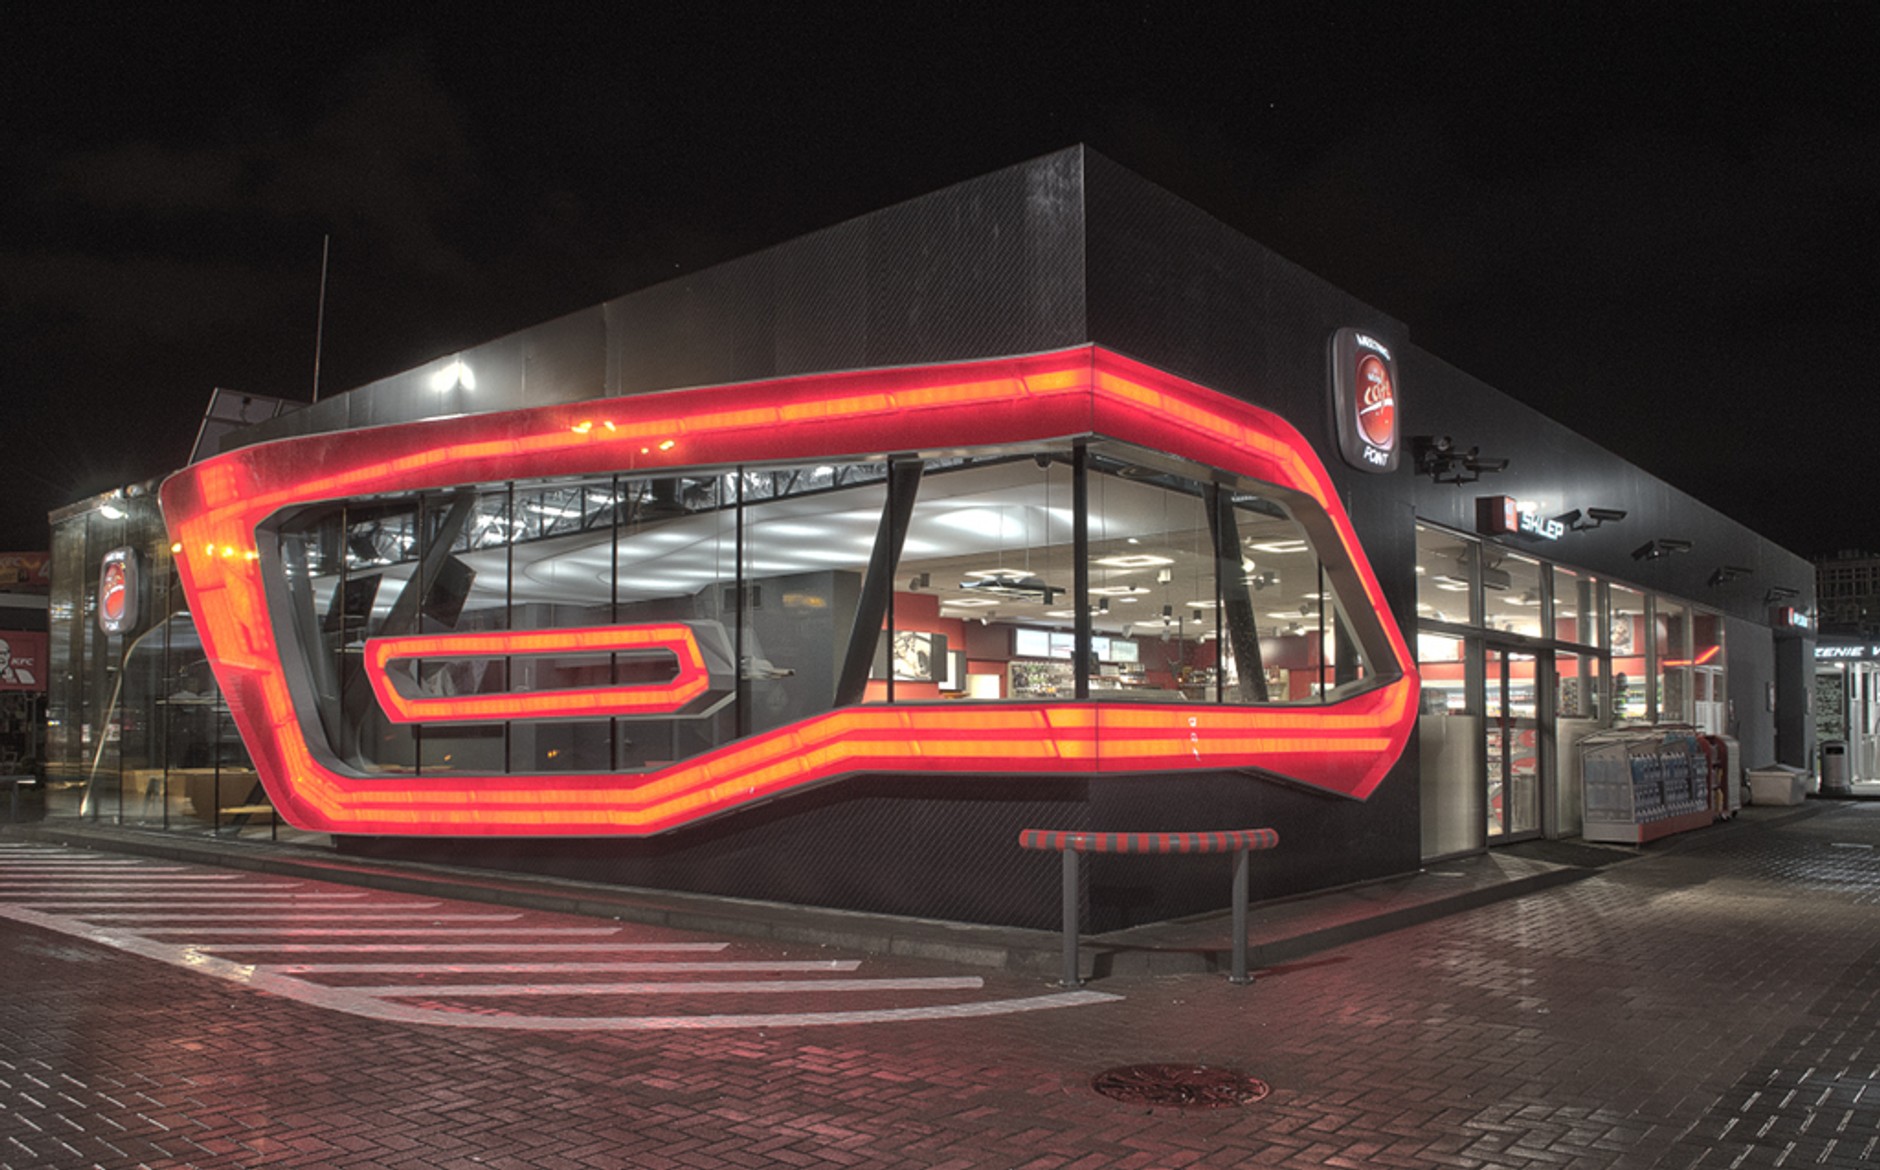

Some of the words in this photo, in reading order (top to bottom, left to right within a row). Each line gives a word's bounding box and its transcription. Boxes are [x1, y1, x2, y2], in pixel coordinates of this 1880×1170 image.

[1363, 445, 1390, 467] POINT
[1520, 511, 1564, 541] SKLEP
[10, 657, 35, 666] KFC
